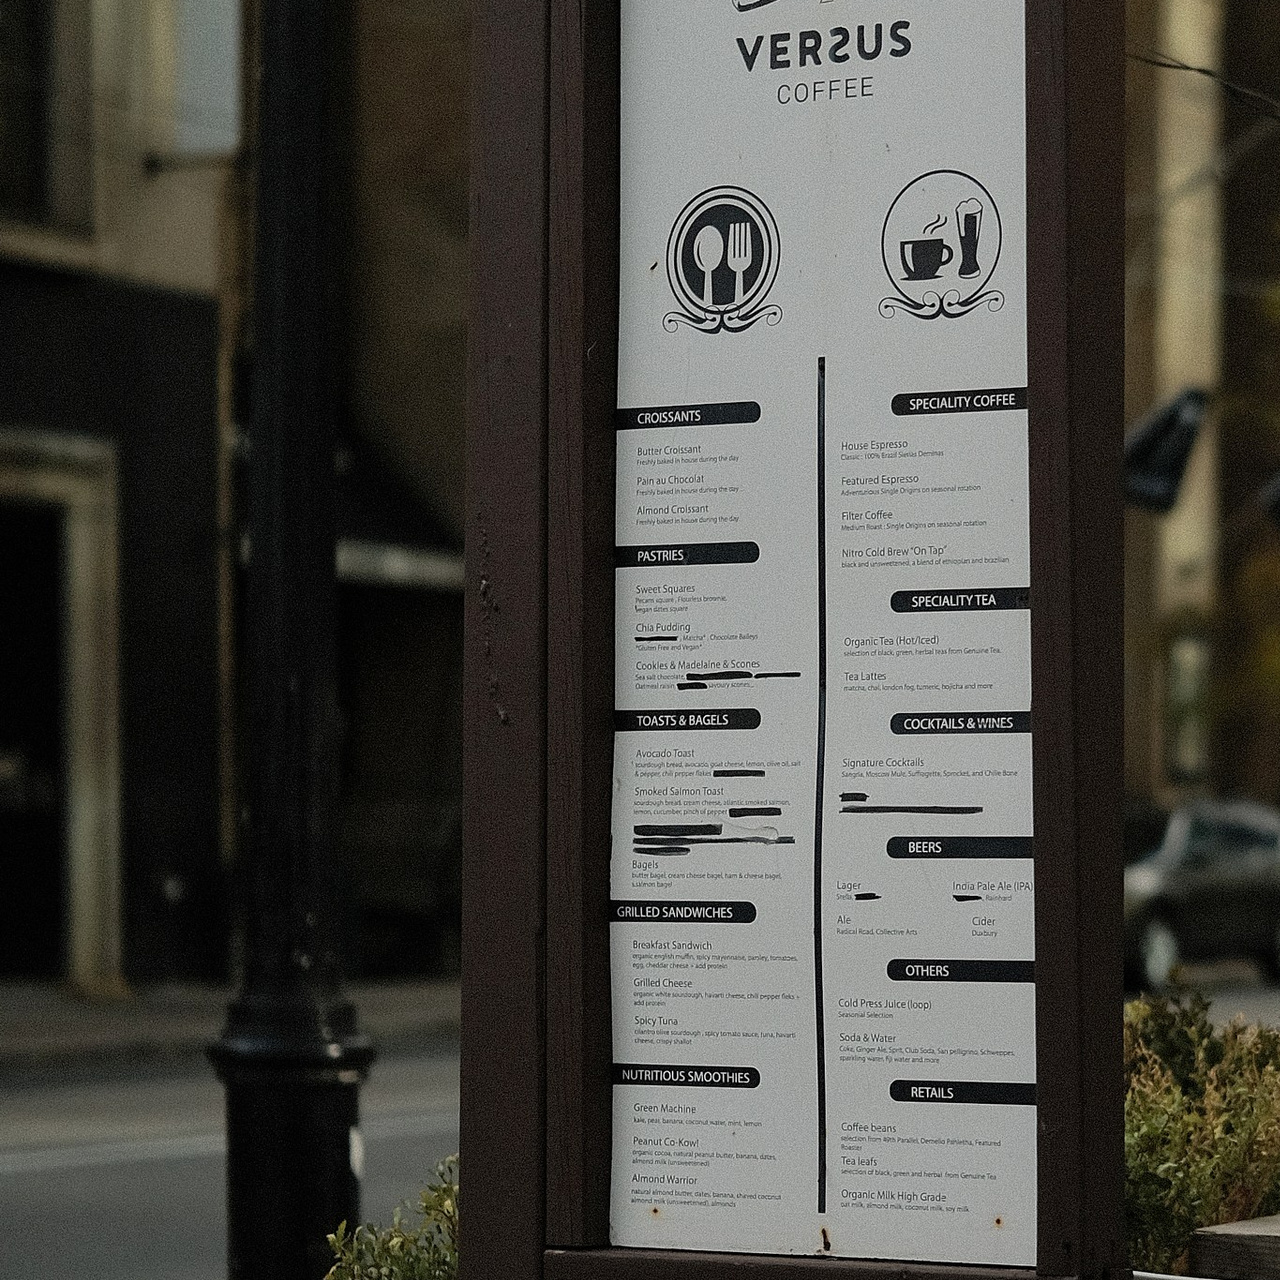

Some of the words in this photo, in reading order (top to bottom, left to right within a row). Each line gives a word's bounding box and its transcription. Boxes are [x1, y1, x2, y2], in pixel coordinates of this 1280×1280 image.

[735, 21, 912, 72] VERSUS
[776, 76, 874, 105] COFFEE
[909, 396, 971, 411] SPECIALITY
[973, 394, 1016, 407] COFFEE
[637, 410, 701, 424] CROISSANTS
[637, 446, 662, 456] Butter
[664, 444, 702, 455] Croissant
[841, 441, 869, 451] House
[870, 439, 909, 452] Espresso
[699, 456, 718, 464] during
[637, 476, 655, 486] Pain
[656, 477, 667, 485] au
[668, 474, 705, 484] Chocolat
[841, 475, 879, 486] Featured
[881, 474, 919, 487] Espresso
[637, 505, 670, 515] Almond
[671, 503, 709, 514] Croissant
[841, 511, 863, 521] Filter
[864, 510, 893, 520] Coffee
[637, 549, 684, 562] PASTRIES
[842, 548, 864, 558] Nitro
[865, 548, 885, 557] Cold
[887, 547, 909, 557] Brew
[636, 584, 661, 594] Sweet
[662, 583, 696, 596] Squares
[912, 595, 974, 608] SPECIALITY
[975, 594, 996, 606] TEA
[635, 623, 654, 632] Chia
[656, 622, 691, 634] Pudding
[844, 637, 878, 649] Organic
[879, 636, 894, 646] Tea
[896, 635, 940, 647] (Hot/Iced)
[636, 660, 668, 670] Cookies
[670, 660, 676, 670] &
[678, 659, 721, 669] Madelaine
[722, 659, 729, 668] &
[731, 658, 760, 668] Scones
[844, 671, 859, 681] Tea
[860, 671, 887, 681] Lattes
[636, 715, 677, 727] TOASTS
[679, 715, 687, 726] &
[689, 714, 729, 726] BAGELS
[904, 718, 964, 730] COCKTAILS
[966, 718, 976, 729] &
[977, 717, 1014, 729] WINES
[636, 749, 672, 758] Avocado
[673, 748, 695, 758] Toast
[842, 757, 884, 769] Signature
[885, 757, 924, 767] Cocktails
[634, 787, 668, 796] Smoked
[670, 787, 701, 796] Salmon
[702, 787, 724, 796] Toast
[908, 842, 942, 853] BEERS
[632, 860, 659, 871] Bagels
[837, 881, 861, 892] Lager
[952, 882, 975, 891] India
[977, 882, 996, 891] Pale
[997, 882, 1012, 891] Ale
[1014, 882, 1033, 893] (IPA)
[617, 906, 660, 918] GRILLED
[662, 907, 733, 918] SANDWICHES
[837, 915, 851, 924] Ale
[972, 917, 996, 926] Cider
[632, 940, 670, 950] Breakfast
[672, 941, 713, 950] Sandwich
[905, 965, 950, 977] OTHERS
[633, 978, 661, 987] Grilled
[662, 978, 693, 988] Cheese
[838, 999, 859, 1008] Cold
[860, 999, 883, 1008] Press
[884, 999, 907, 1009] Juice
[907, 1000, 932, 1011] (loop)
[634, 1016, 657, 1028] Spicy
[658, 1016, 678, 1026] Tuna
[839, 1033, 861, 1042] Soda
[863, 1033, 869, 1042] &
[871, 1033, 897, 1043] Water
[622, 1069, 686, 1082] NUTRITIOUS
[688, 1071, 750, 1084] SMOOTHIES
[911, 1086, 954, 1099] RETAILS
[633, 1103, 659, 1113] Green
[660, 1104, 697, 1114] Machine
[841, 1123, 869, 1133] Coffee
[871, 1124, 897, 1133] beans
[633, 1136, 662, 1146] Peanut
[841, 1156, 856, 1166] Tea
[857, 1157, 878, 1166] leafs
[632, 1174, 665, 1184] Almond
[667, 1175, 698, 1185] Warrior
[841, 1190, 875, 1202] Organic
[877, 1191, 896, 1201] Milk
[897, 1192, 918, 1204] High
[920, 1192, 947, 1202] Grade
